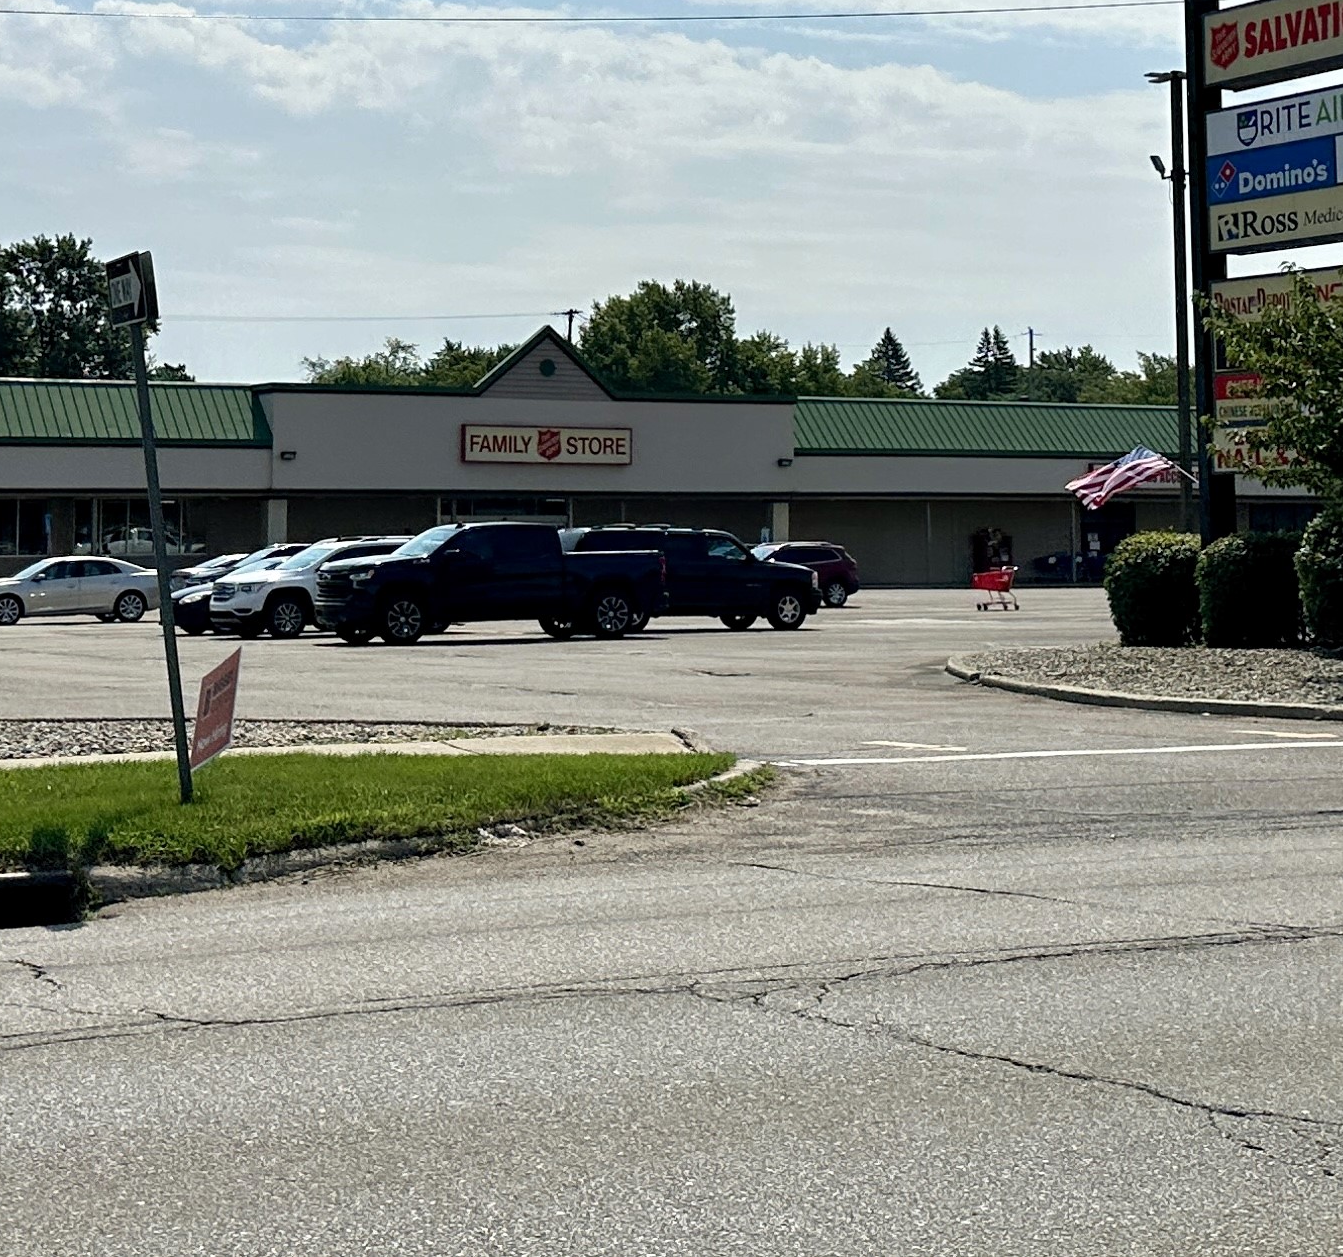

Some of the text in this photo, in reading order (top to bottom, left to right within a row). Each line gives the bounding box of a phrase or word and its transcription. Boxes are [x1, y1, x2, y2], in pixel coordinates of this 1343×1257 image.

[1260, 100, 1312, 137] RITE
[1238, 158, 1329, 194] Domino's
[470, 434, 533, 454] FAMILY
[566, 436, 627, 455] STORE
[1217, 447, 1265, 469] NAL
